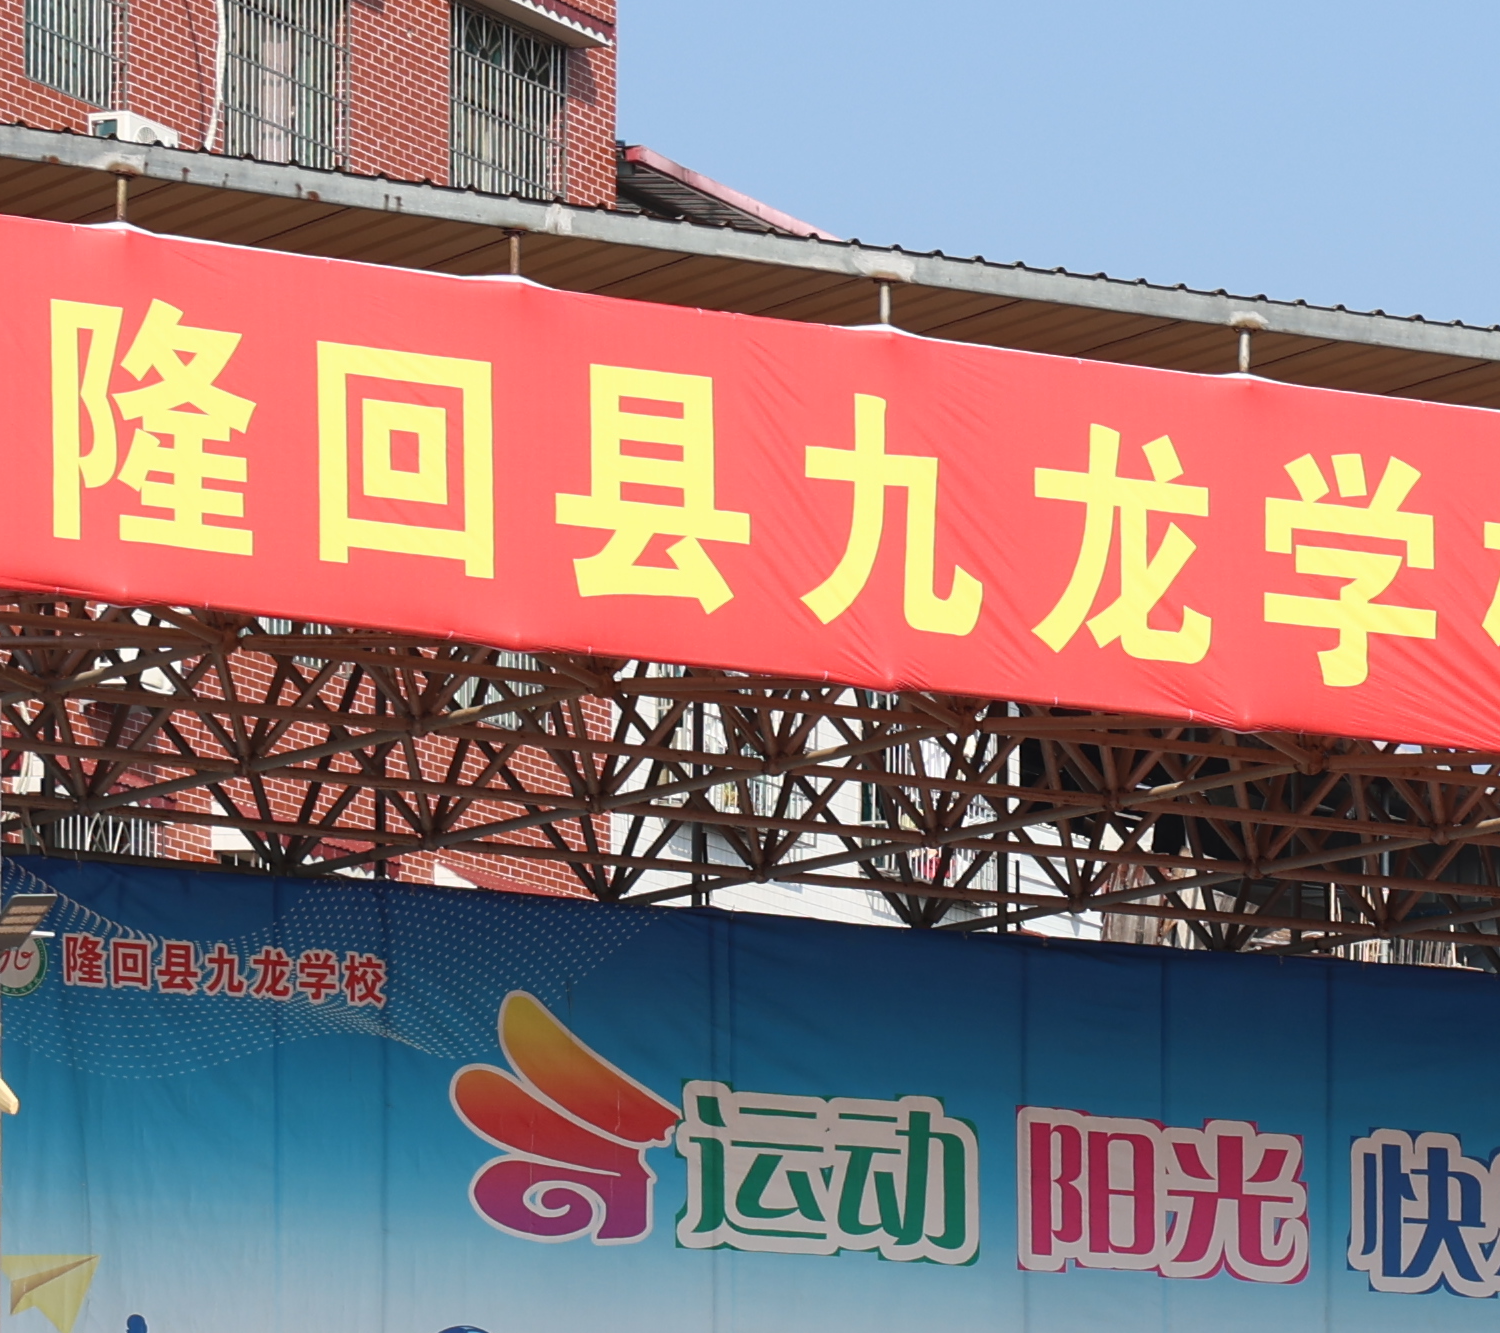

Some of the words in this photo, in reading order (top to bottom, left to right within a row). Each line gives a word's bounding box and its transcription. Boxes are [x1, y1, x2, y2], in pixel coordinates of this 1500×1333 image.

[63, 933, 387, 1005] 隆回县九龙学校
[684, 1087, 972, 1258] 运动
[1022, 1113, 1302, 1276] 阳光
